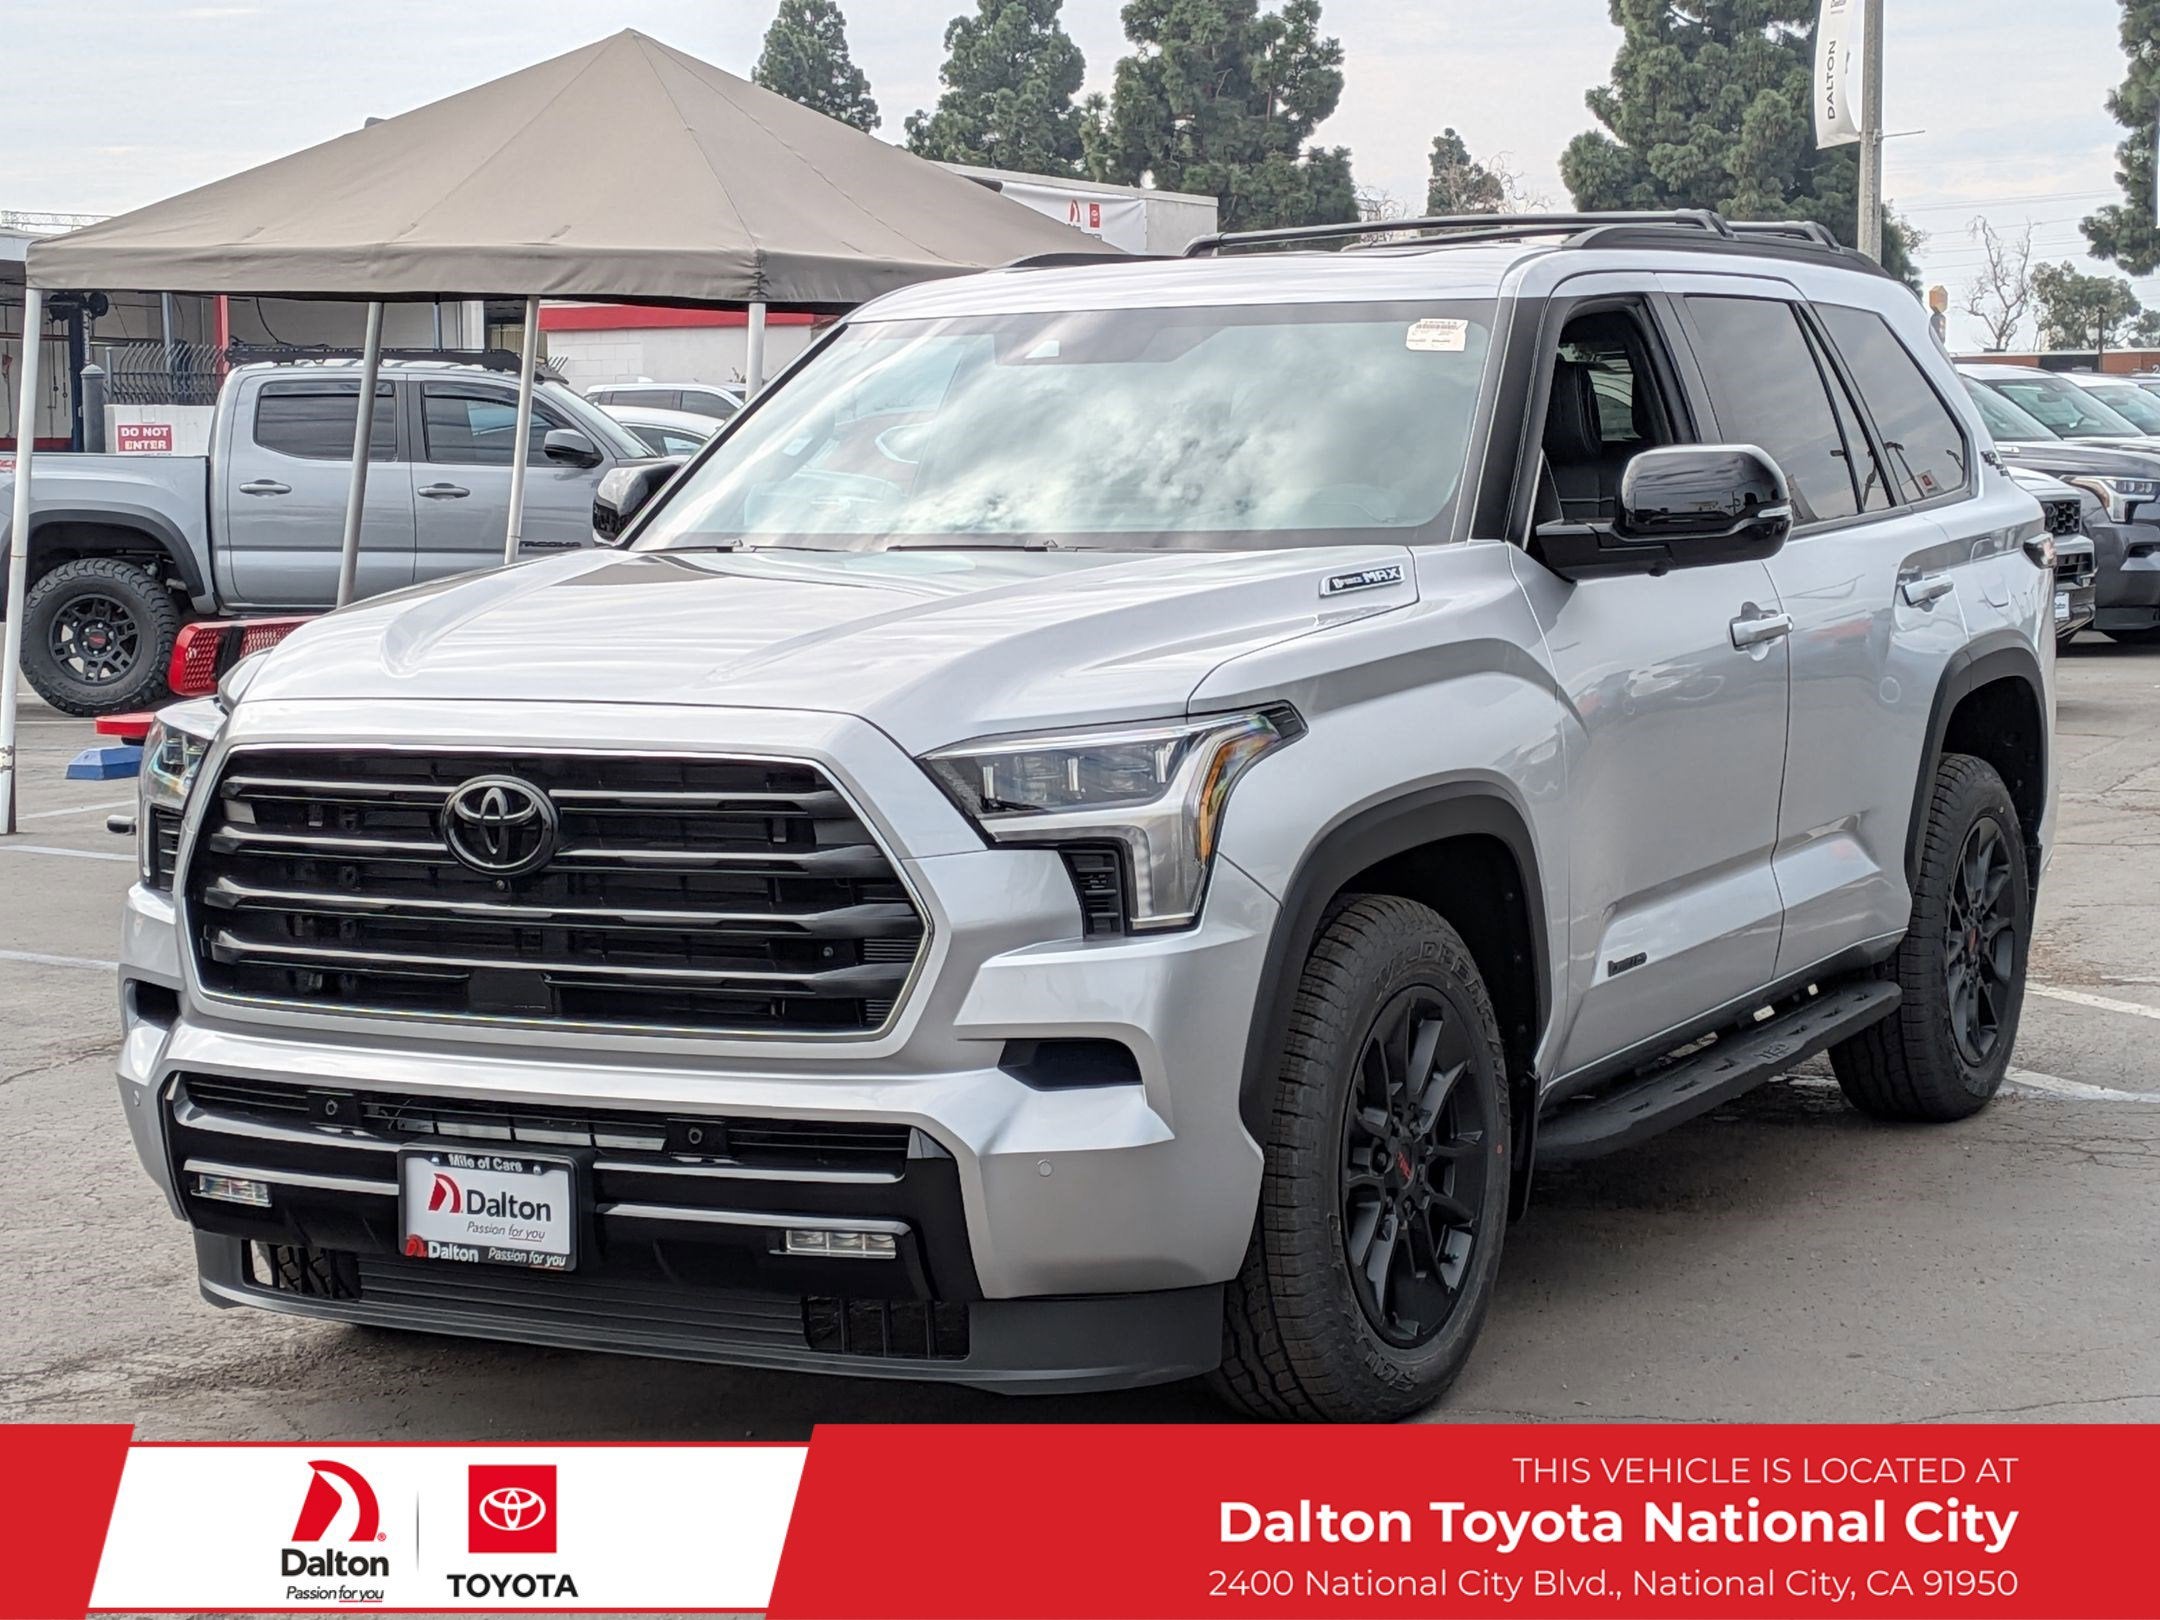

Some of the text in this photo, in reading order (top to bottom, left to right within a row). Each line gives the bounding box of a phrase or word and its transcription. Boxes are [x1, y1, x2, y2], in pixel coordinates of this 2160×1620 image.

[1826, 40, 1837, 120] DALTON
[120, 427, 169, 437] DO NOT
[124, 440, 167, 450] ENTER
[1362, 568, 1400, 583] MAX
[448, 1153, 524, 1174] Mile of Cars
[466, 1189, 551, 1222] Dalton
[466, 1220, 546, 1241] Passion for you
[428, 1241, 567, 1268] Dalton Passion for you
